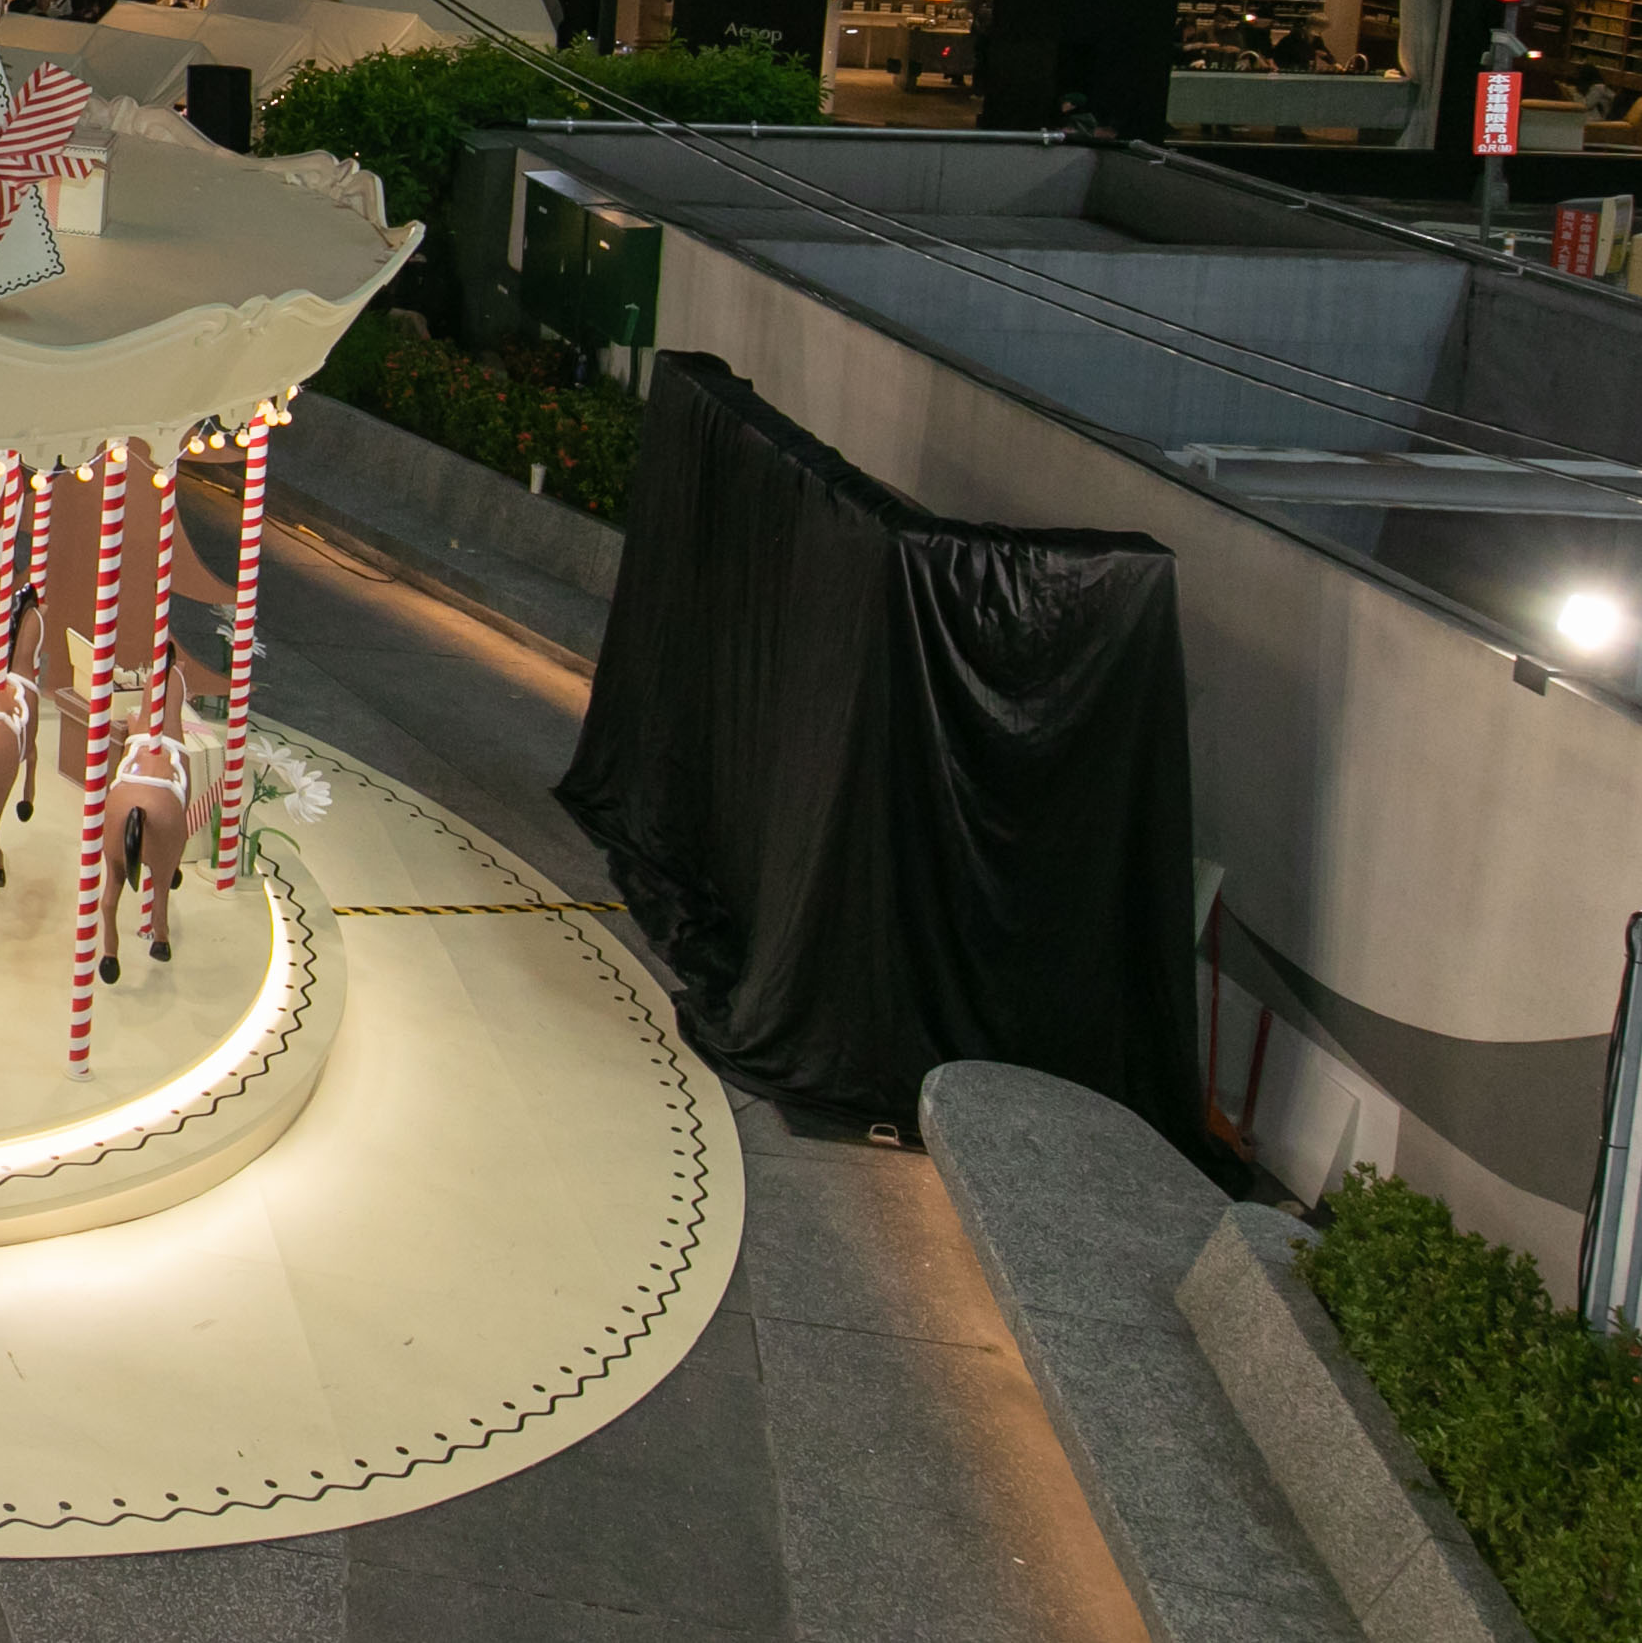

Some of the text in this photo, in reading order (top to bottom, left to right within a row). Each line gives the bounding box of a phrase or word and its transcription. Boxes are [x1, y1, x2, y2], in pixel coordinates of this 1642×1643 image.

[1485, 74, 1511, 133] 本停車場限高
[1483, 134, 1508, 144] 1.8
